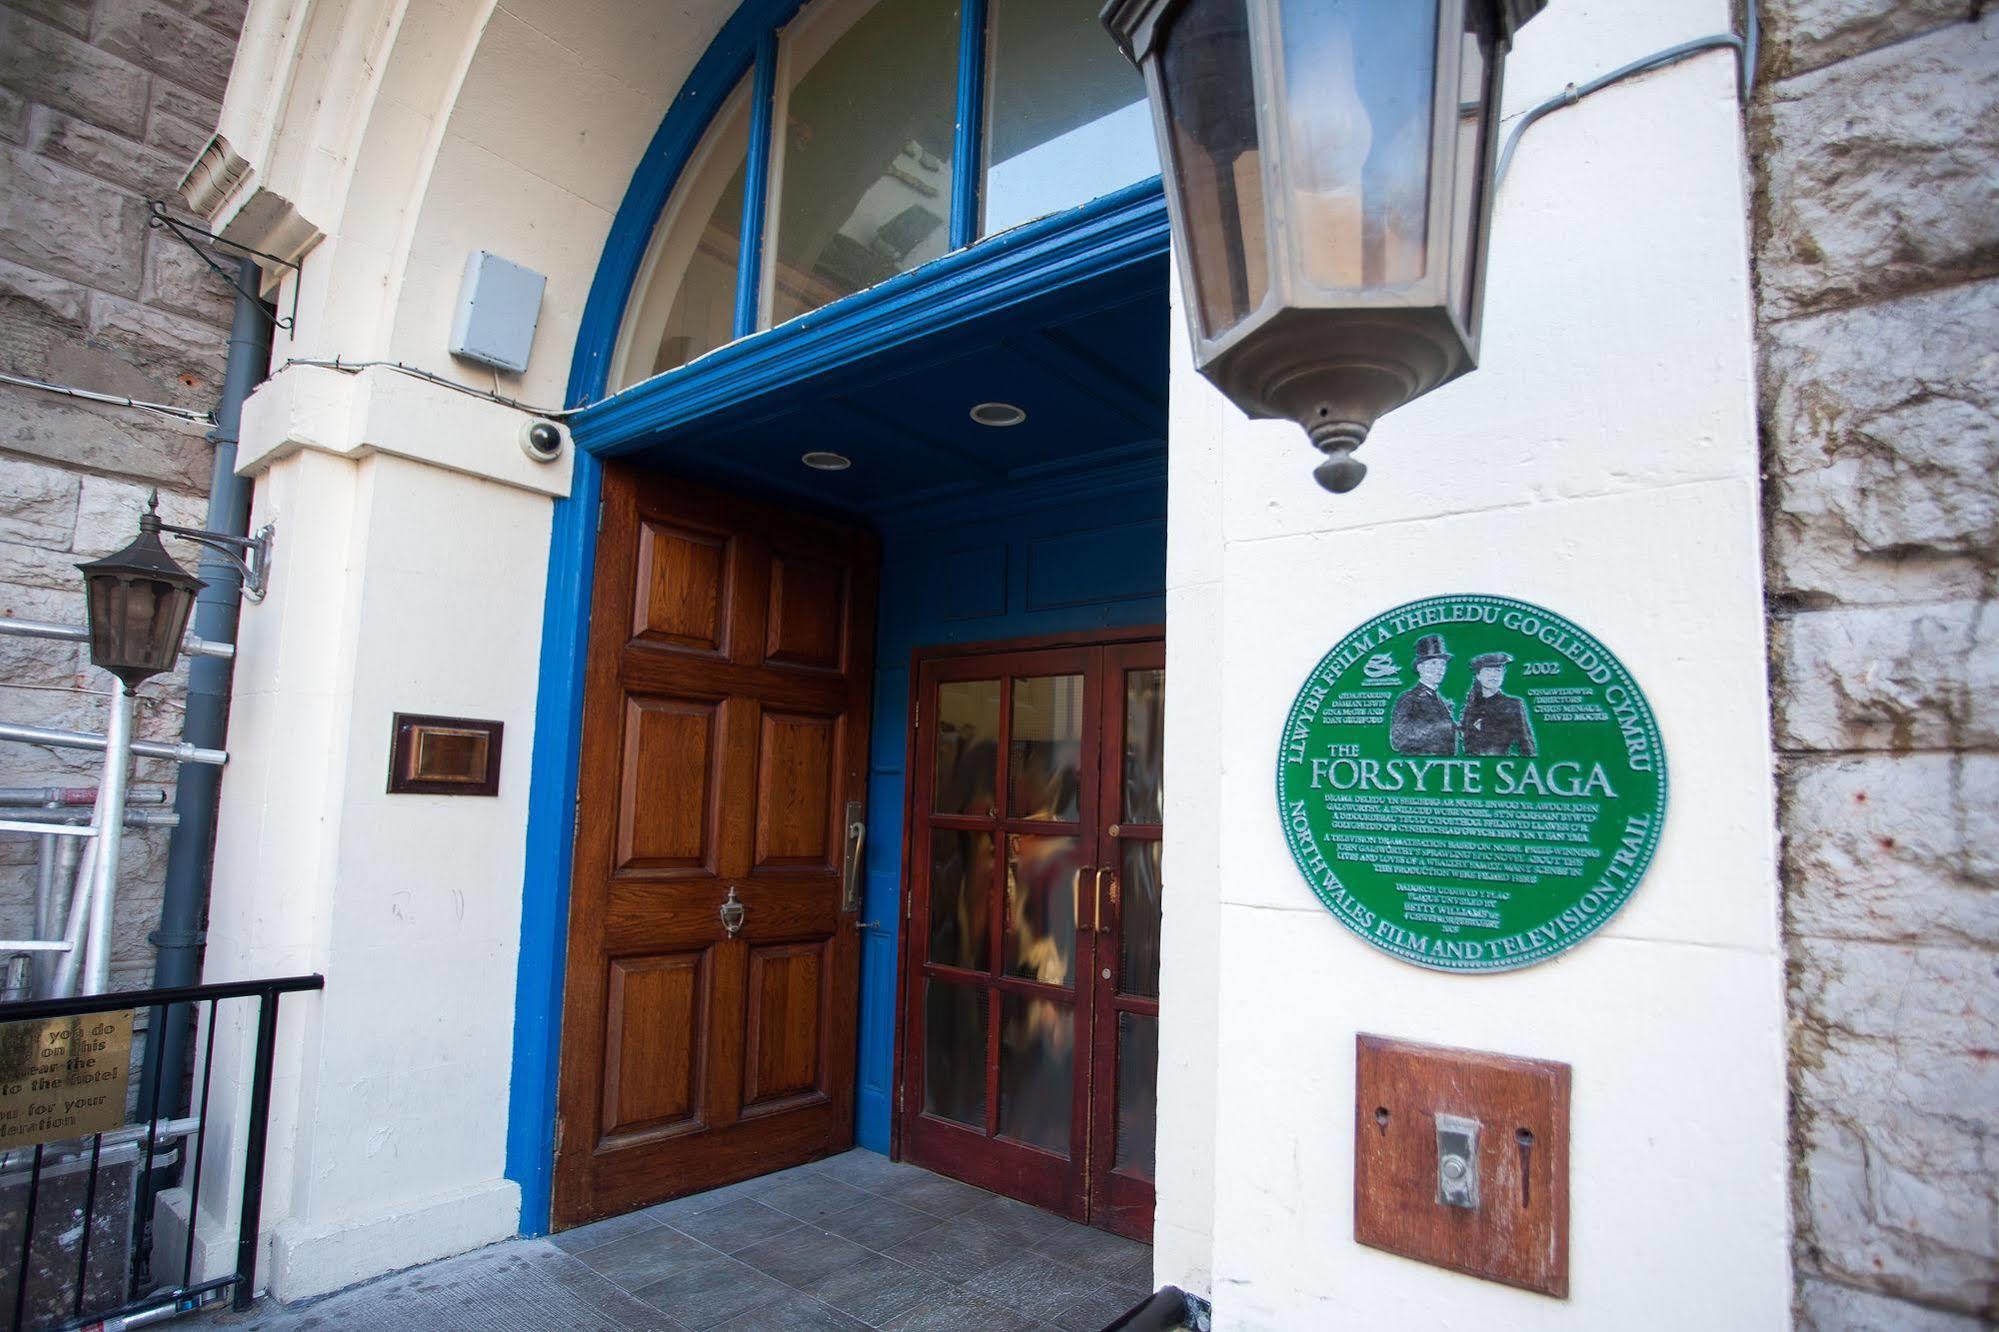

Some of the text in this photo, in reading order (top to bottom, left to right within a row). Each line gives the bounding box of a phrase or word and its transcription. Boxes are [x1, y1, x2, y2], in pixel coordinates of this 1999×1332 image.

[1523, 662, 1560, 676] 2002
[1288, 605, 1652, 772] LLWYBR FFILM A THELEDU GOGLEDD CYMRU
[1327, 744, 1360, 757] THE
[1310, 757, 1619, 799] FORSYTE SAGA
[1360, 853, 1379, 862] AND
[1393, 866, 1449, 876] PRODUCTION
[1289, 800, 1651, 959] NORTH WALES FILM AND TELEVISION TRAIL
[91, 1023, 116, 1036] do
[41, 1046, 66, 1057] on
[66, 1057, 97, 1071] the
[2, 1066, 119, 1096] to the hotel
[28, 1103, 56, 1117] for
[65, 1095, 107, 1114] your
